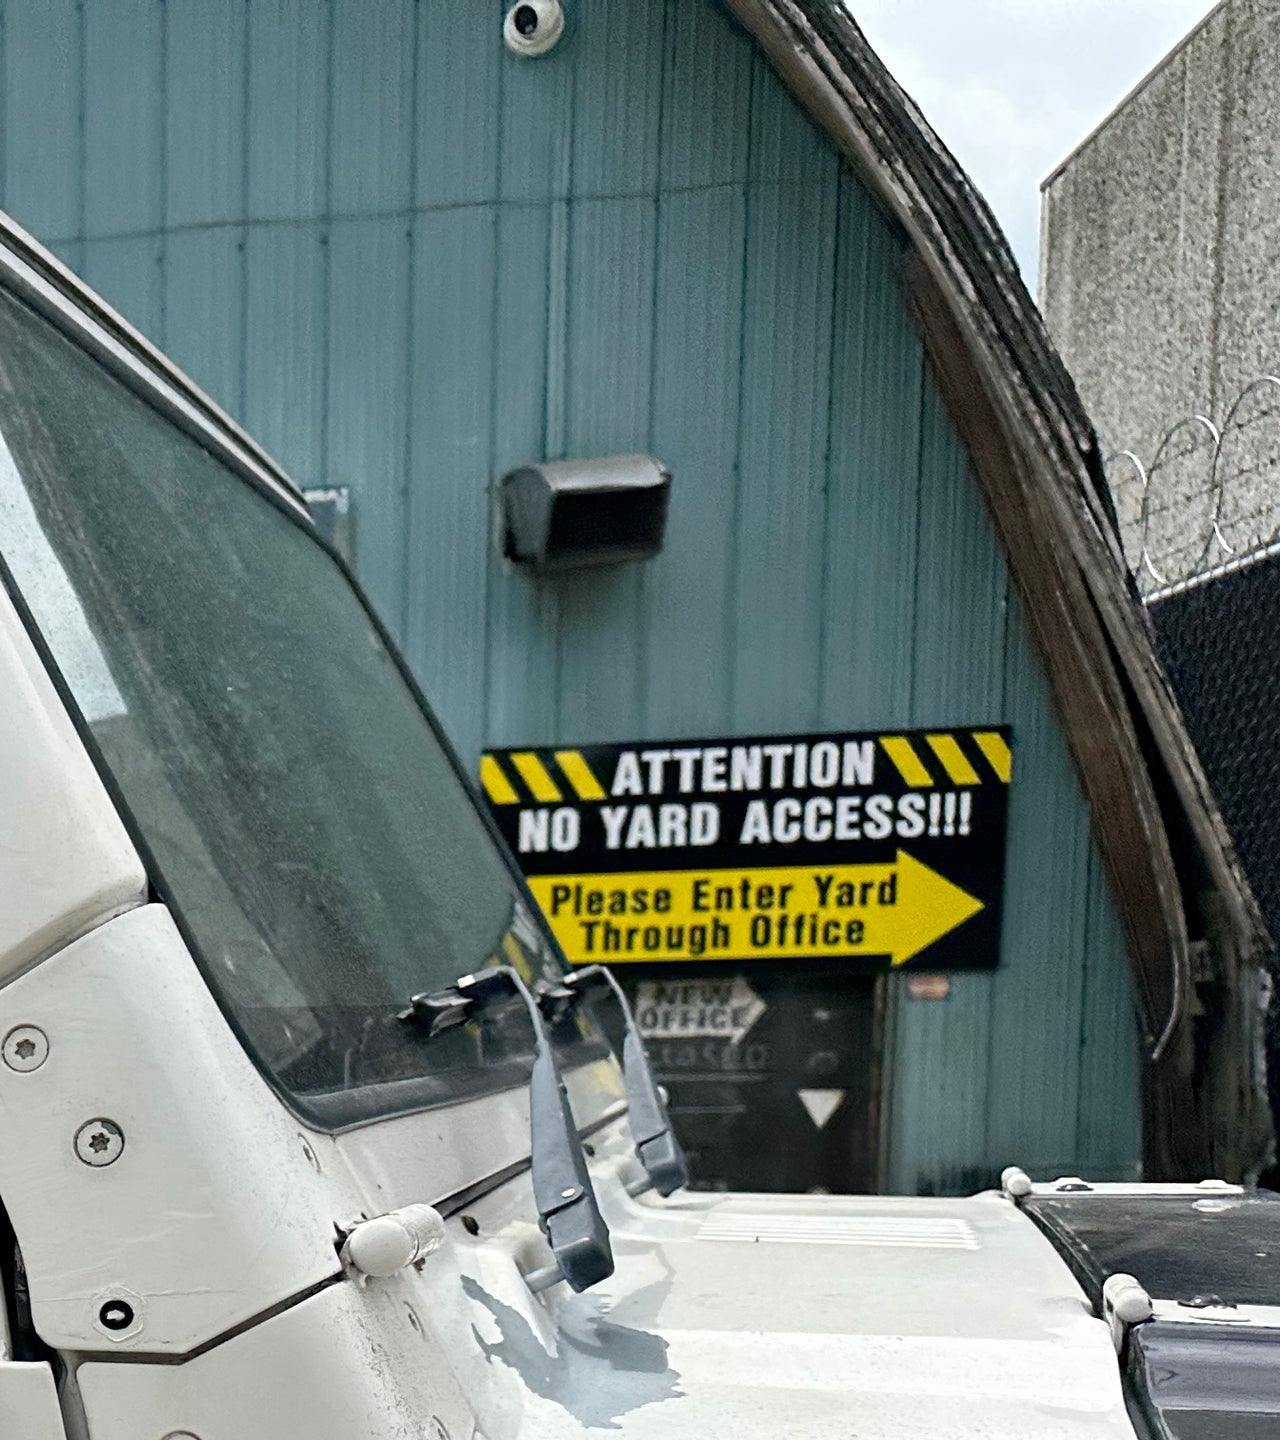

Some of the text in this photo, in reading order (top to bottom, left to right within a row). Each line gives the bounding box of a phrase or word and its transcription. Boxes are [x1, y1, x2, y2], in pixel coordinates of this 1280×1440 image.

[610, 740, 875, 797] ATTENTION
[518, 791, 972, 853] NO YARD ACCESS!!!
[550, 873, 898, 917] Please Enter Yard
[579, 911, 865, 955] Through Office
[641, 1006, 747, 1030] OFFICE
